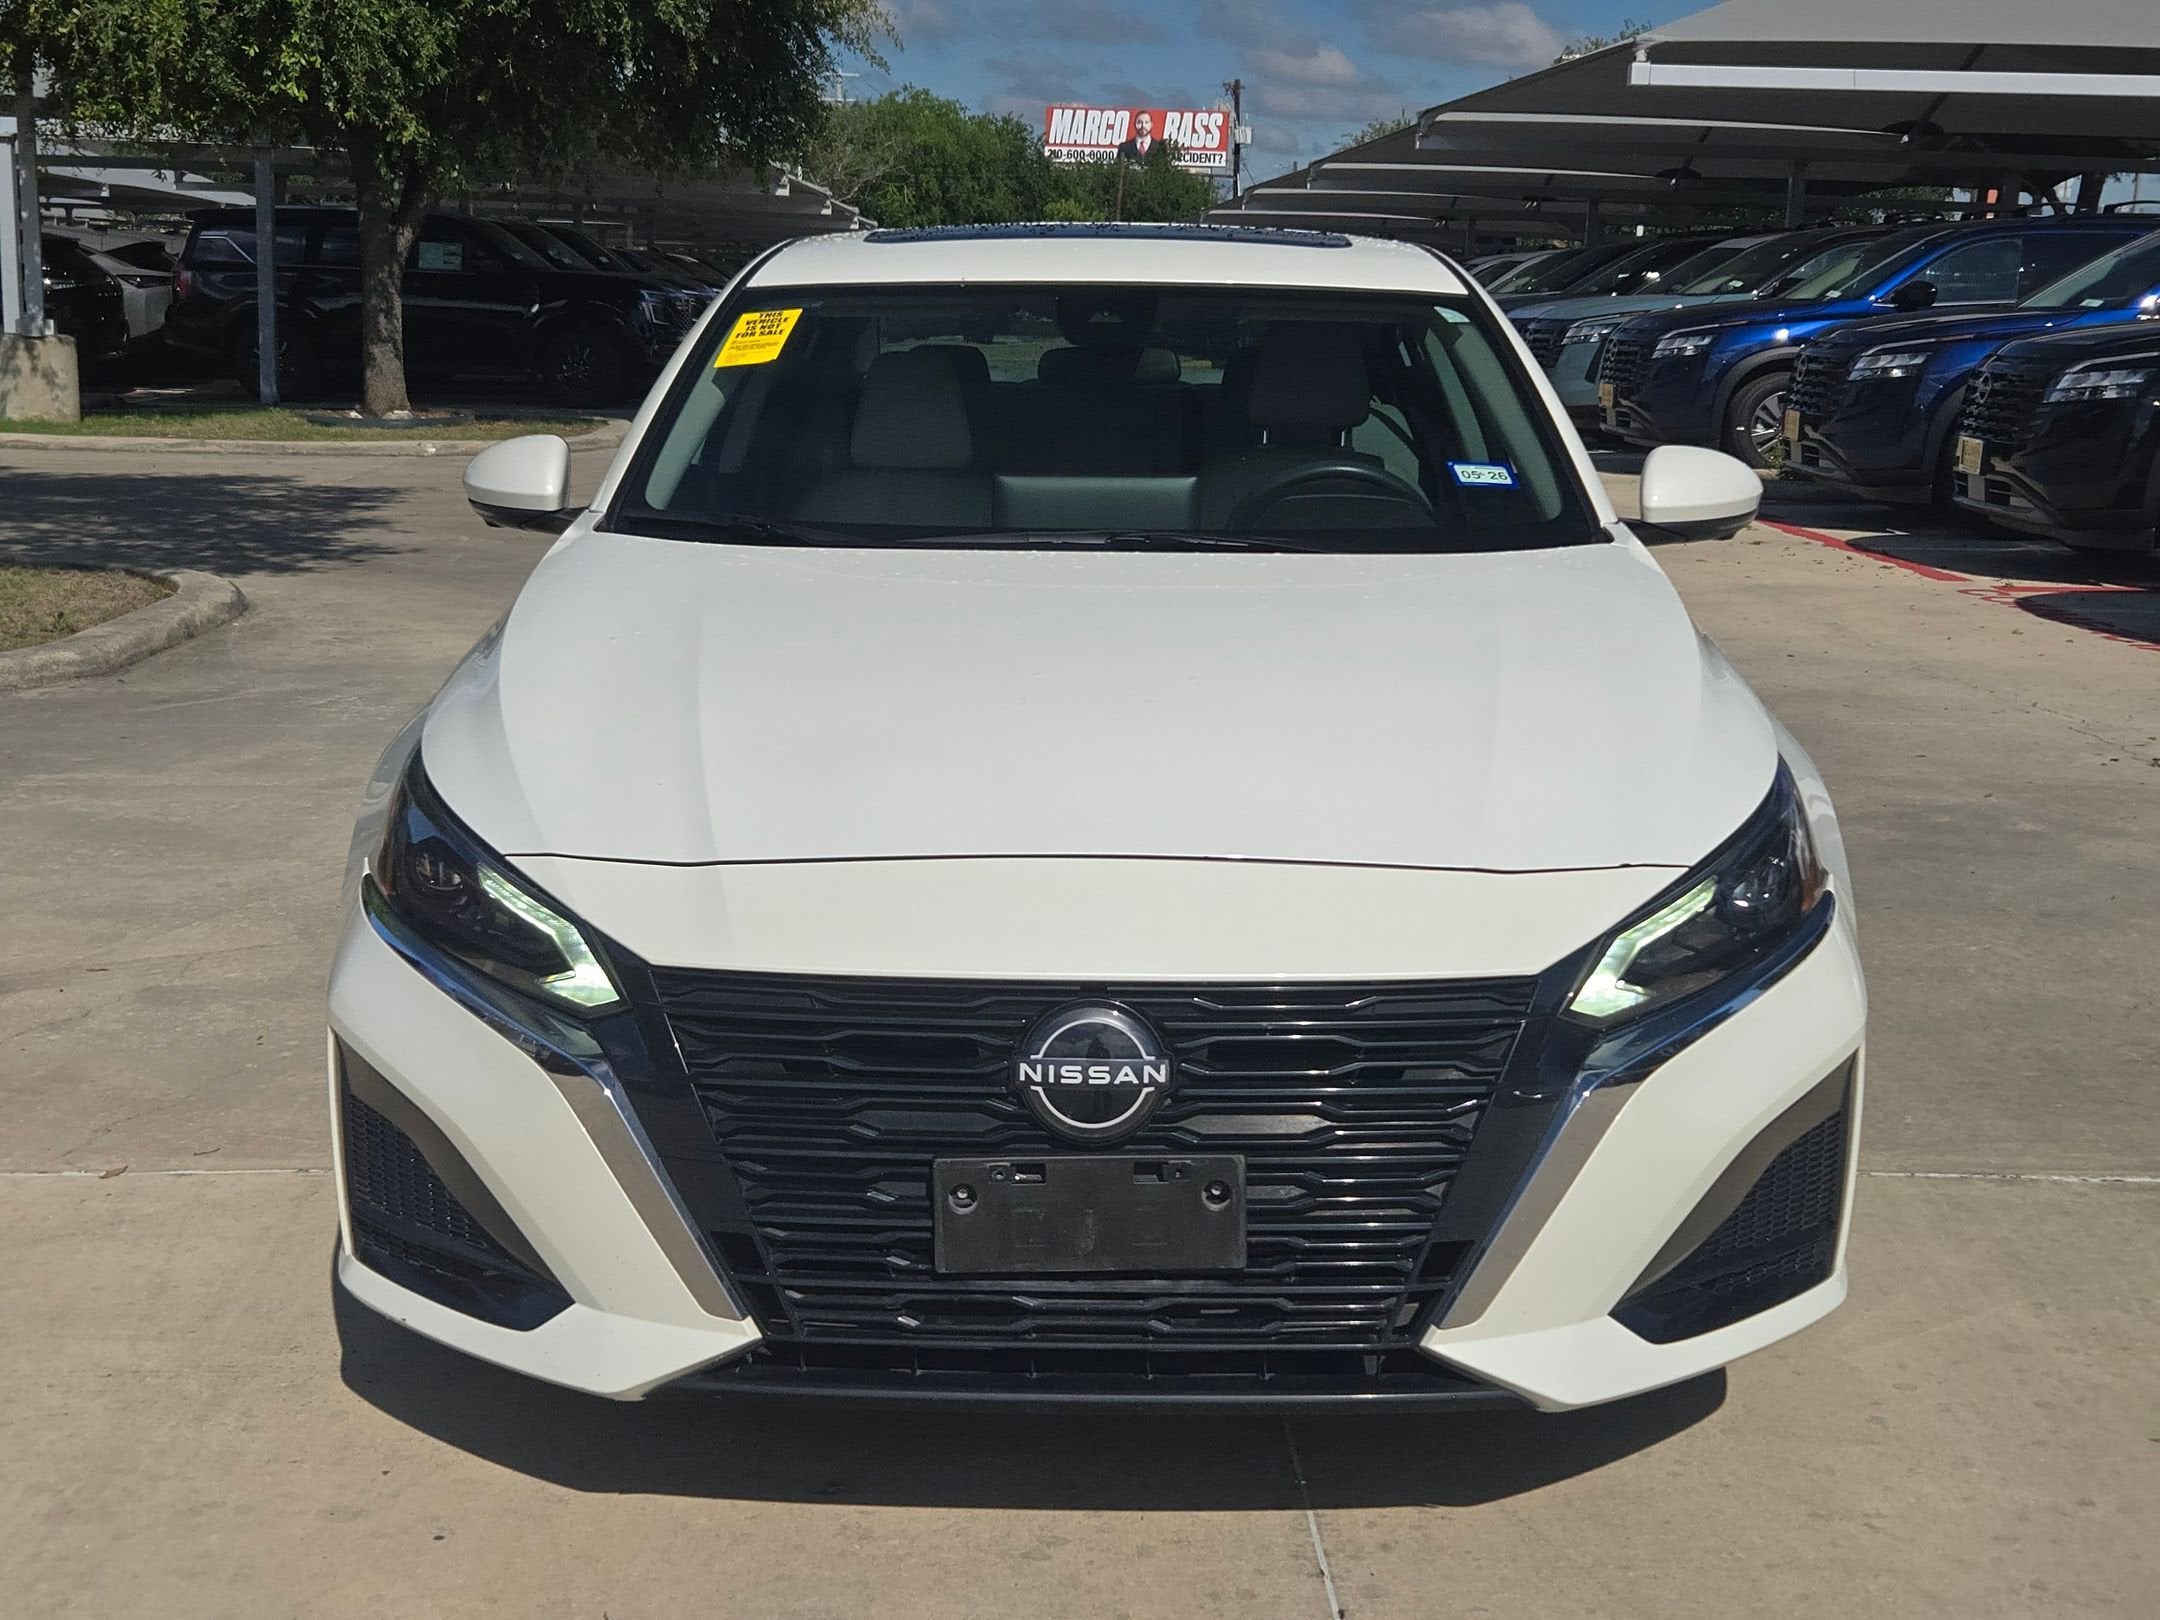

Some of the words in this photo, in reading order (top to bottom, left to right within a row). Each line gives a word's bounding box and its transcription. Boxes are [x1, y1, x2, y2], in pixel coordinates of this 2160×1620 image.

[1049, 109, 1130, 146] MARCO
[746, 317, 788, 325] VEHICLE
[1487, 471, 1508, 480] 26
[1019, 1062, 1166, 1085] NISSAN
